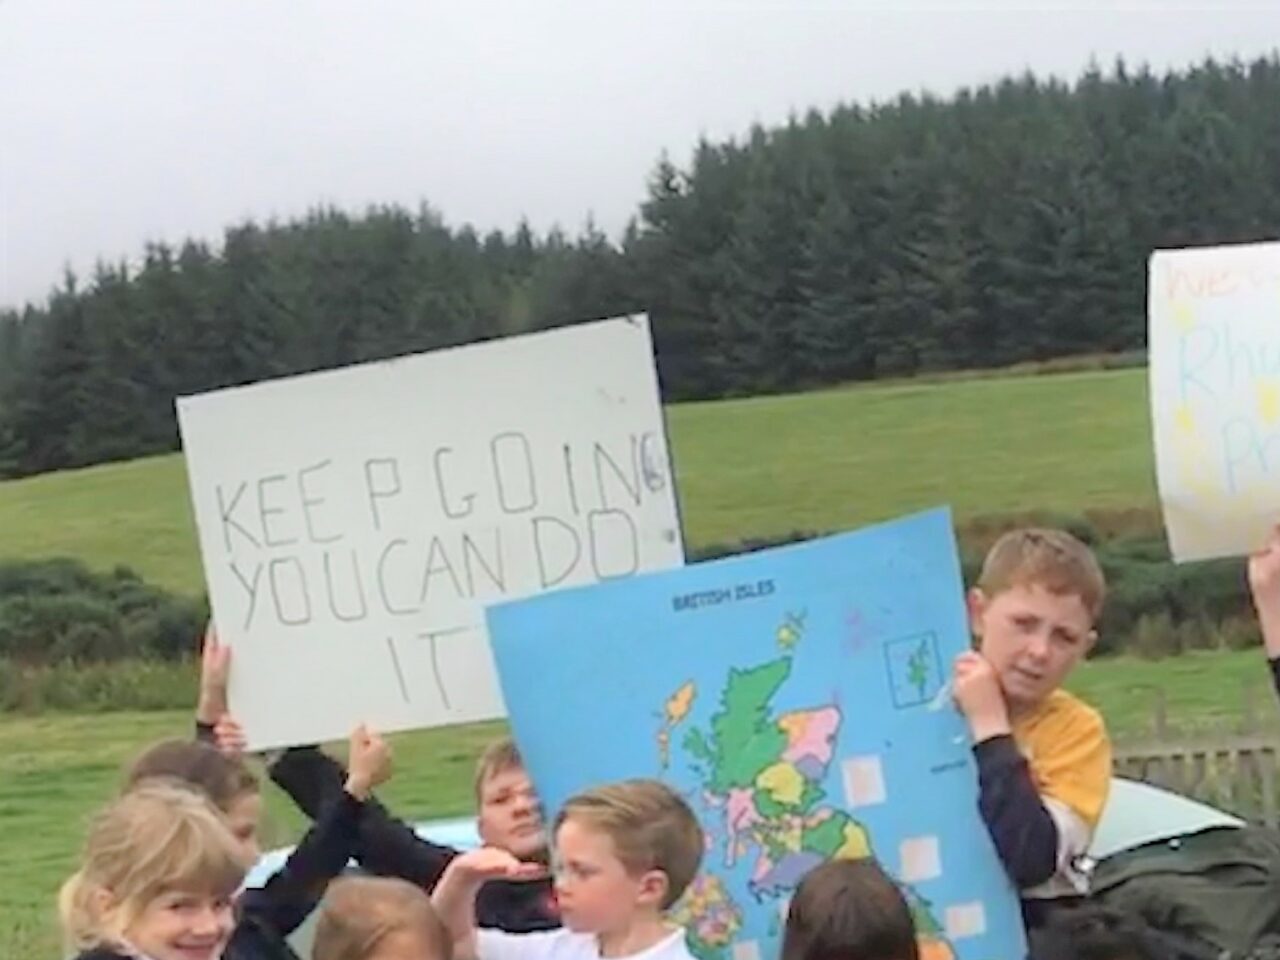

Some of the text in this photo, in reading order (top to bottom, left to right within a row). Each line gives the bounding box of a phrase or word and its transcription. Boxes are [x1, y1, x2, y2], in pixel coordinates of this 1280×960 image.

[216, 432, 665, 553] KEEP GOING
[532, 508, 640, 589] DO
[387, 627, 472, 710] IT
